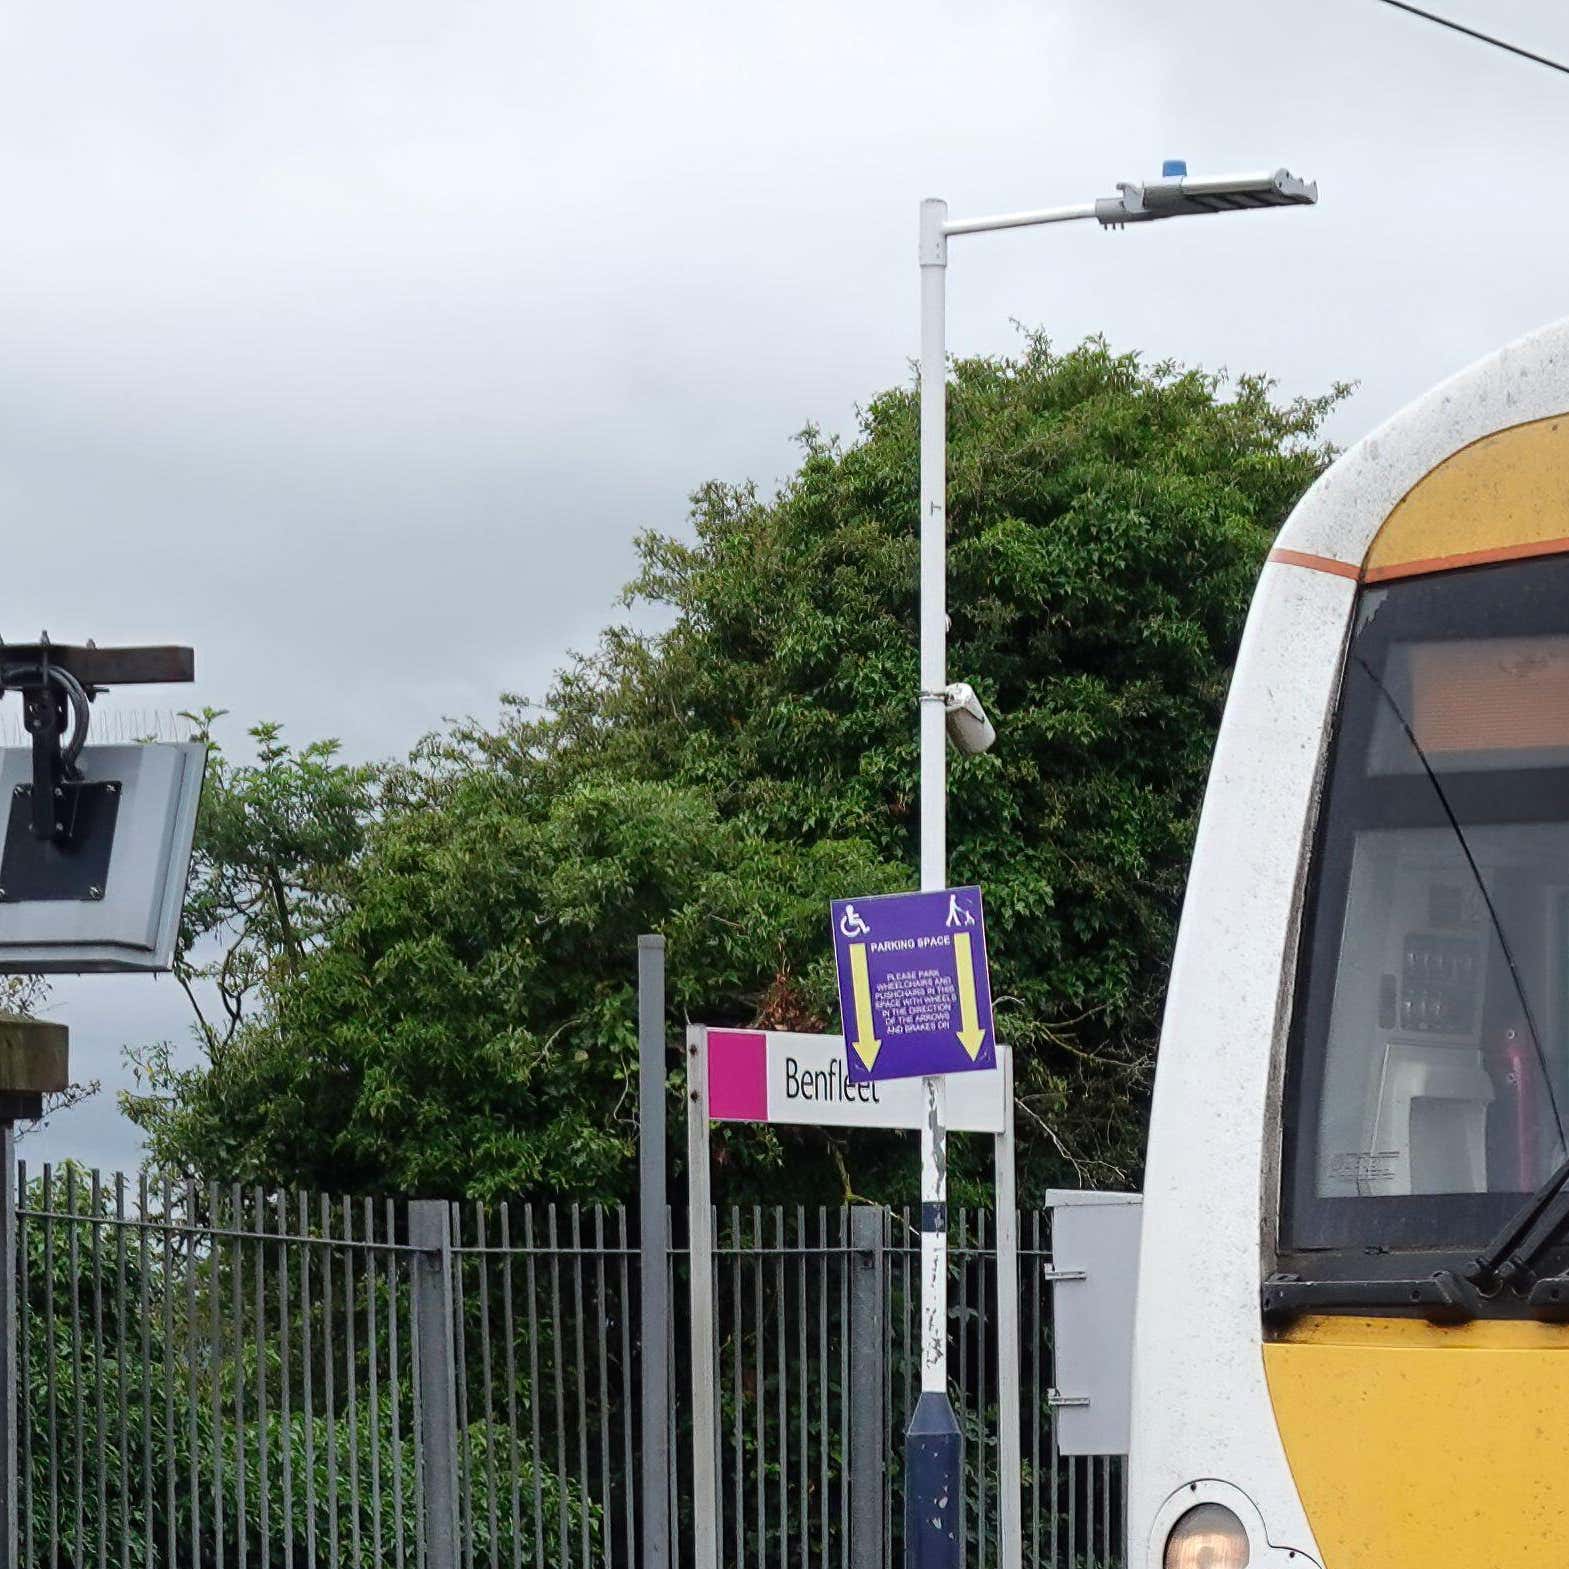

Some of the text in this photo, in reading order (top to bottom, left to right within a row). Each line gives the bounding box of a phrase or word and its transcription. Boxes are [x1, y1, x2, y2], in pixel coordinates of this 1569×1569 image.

[871, 935, 951, 952] PARKING SPACE
[887, 969, 940, 981] PLEASE PARK
[877, 976, 952, 991] WHEELCHAIRS AND
[875, 987, 925, 999] PUSHCHAIRS
[938, 984, 955, 993] THIS
[875, 994, 957, 1009] SPACE WITH WHEELS
[892, 1006, 907, 1016] THE
[909, 1003, 951, 1014] DIRECTION
[899, 1015, 913, 1024] THE
[916, 1011, 950, 1022] ARROWS
[887, 1024, 903, 1034] AND
[905, 1022, 935, 1033] BRAKES
